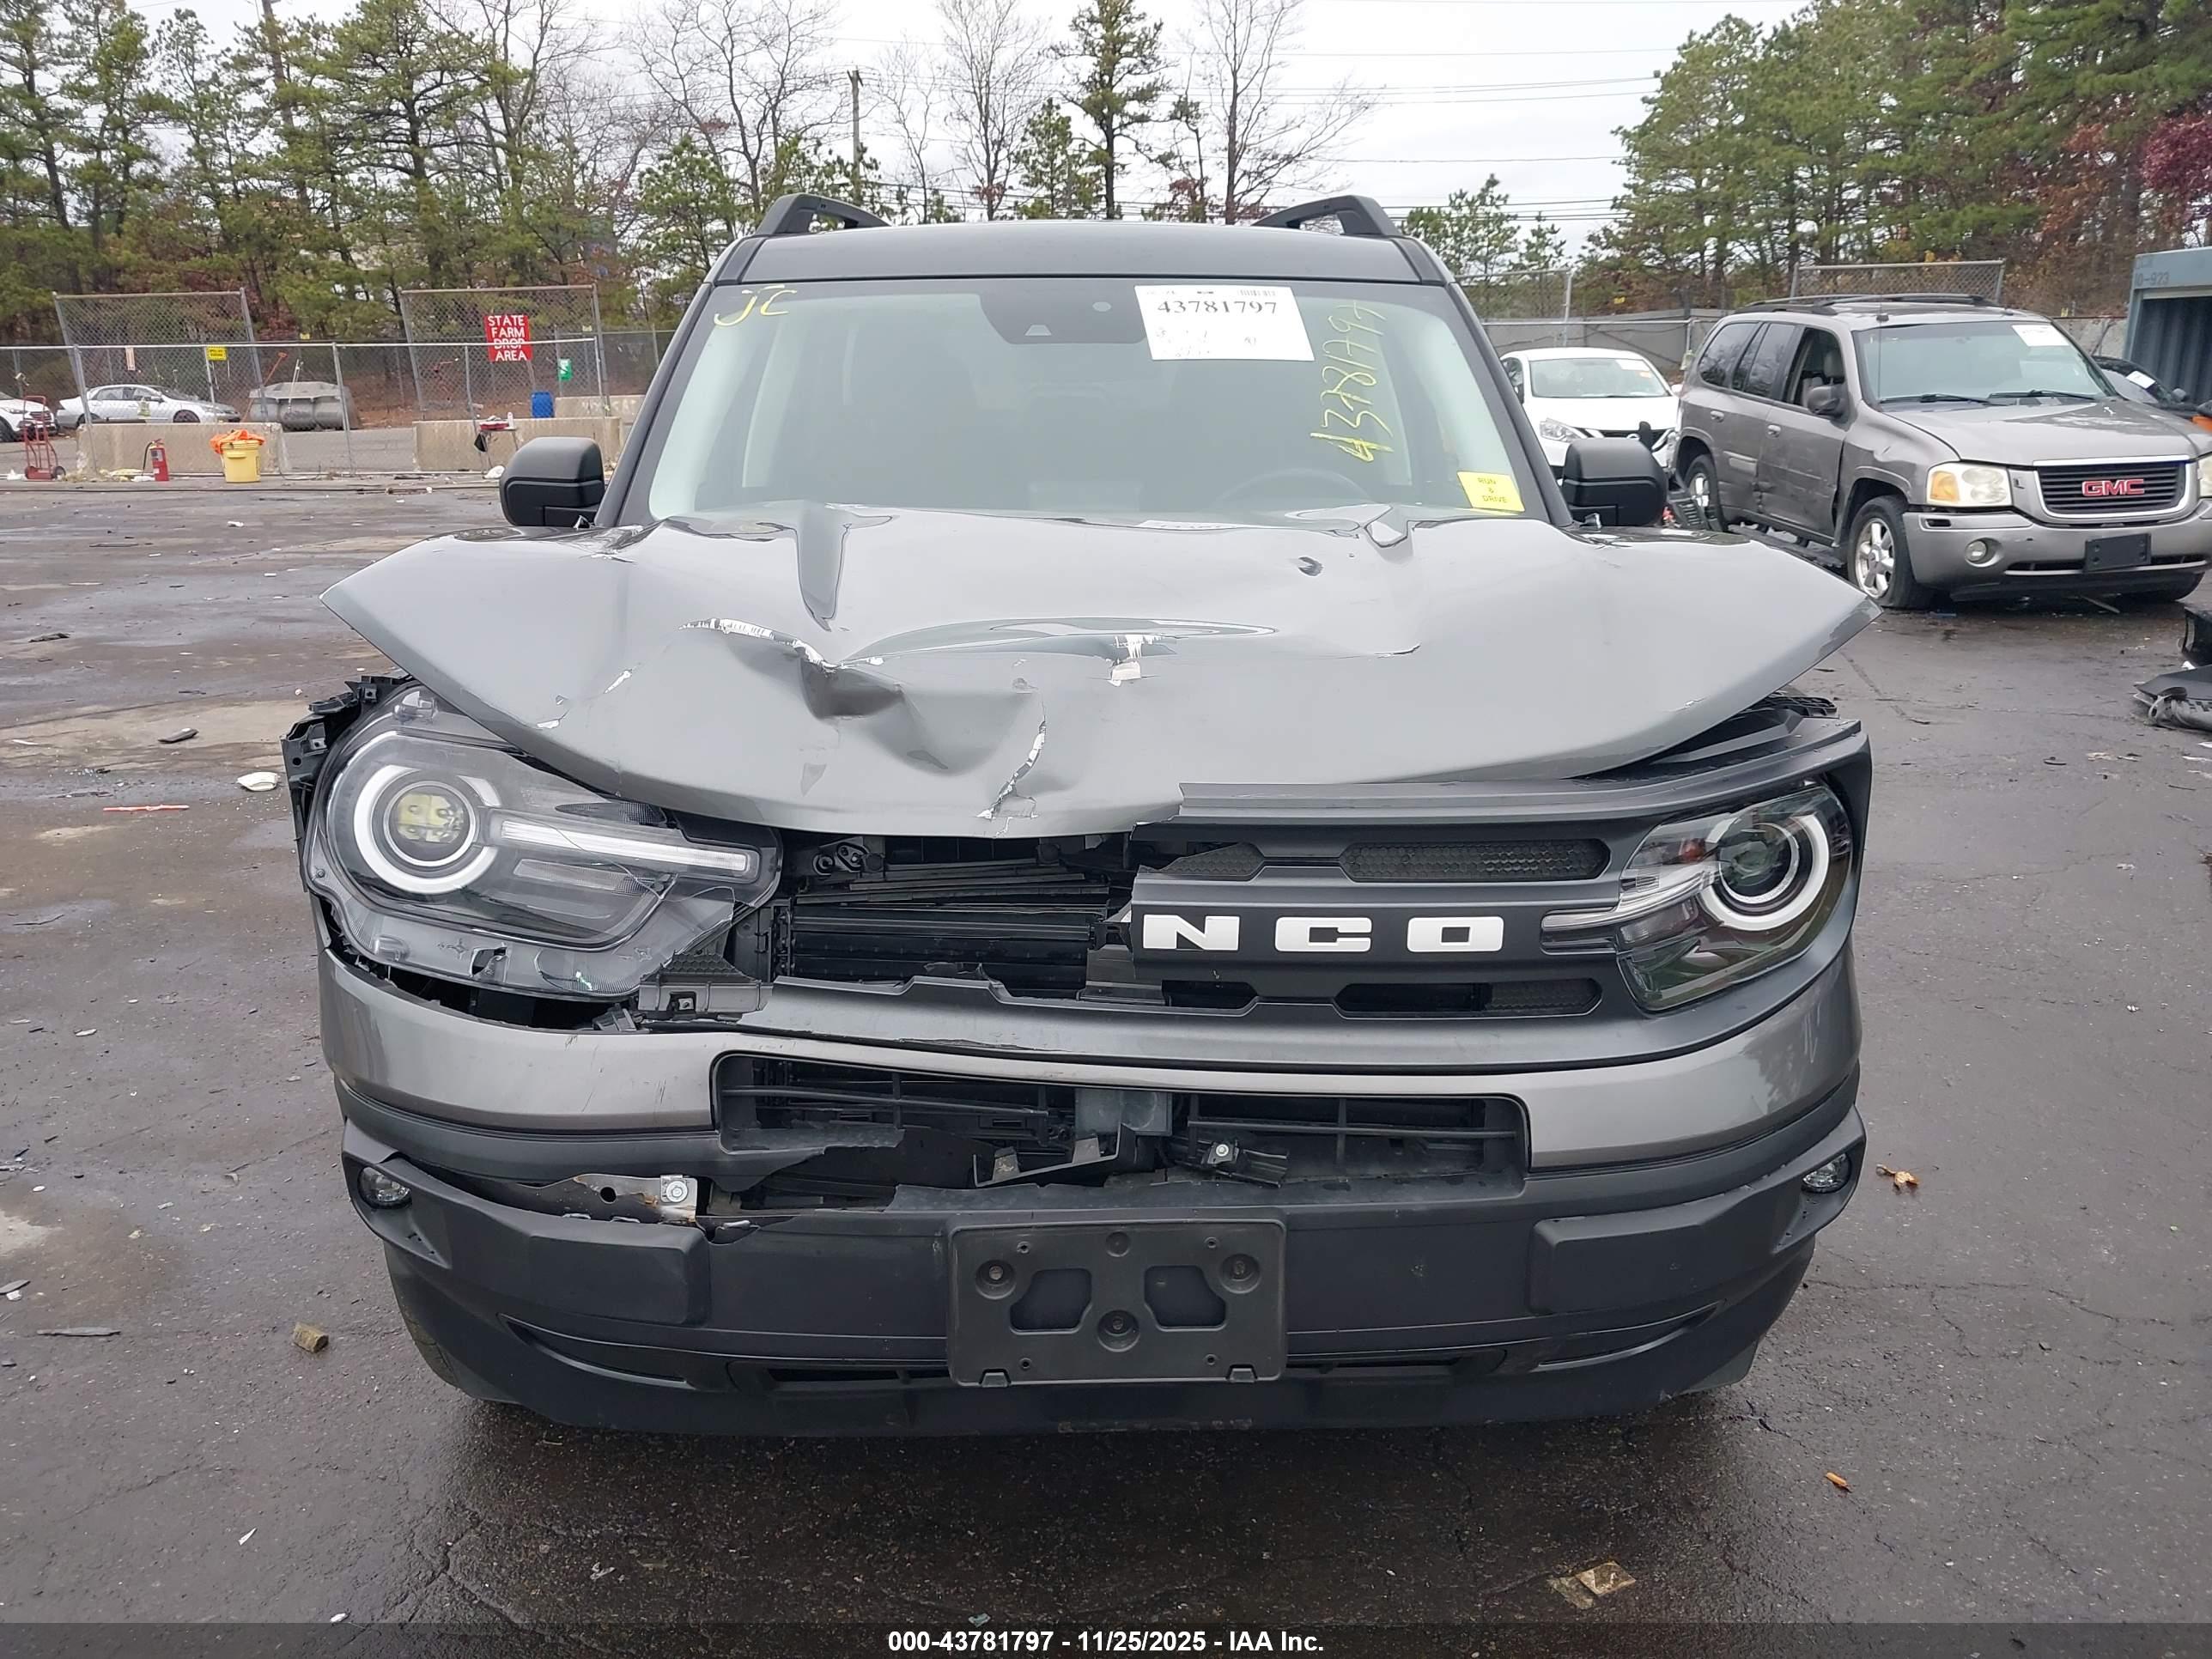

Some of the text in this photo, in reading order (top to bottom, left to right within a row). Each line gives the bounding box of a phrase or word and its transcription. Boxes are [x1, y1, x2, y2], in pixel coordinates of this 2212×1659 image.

[1157, 300, 1278, 315] 43781797
[487, 314, 526, 326] STATE
[491, 326, 526, 338] FARM
[494, 337, 525, 349] DROP
[495, 349, 527, 362] AREA
[2081, 478, 2145, 497] GMC
[1481, 495, 1508, 503] DRIVE
